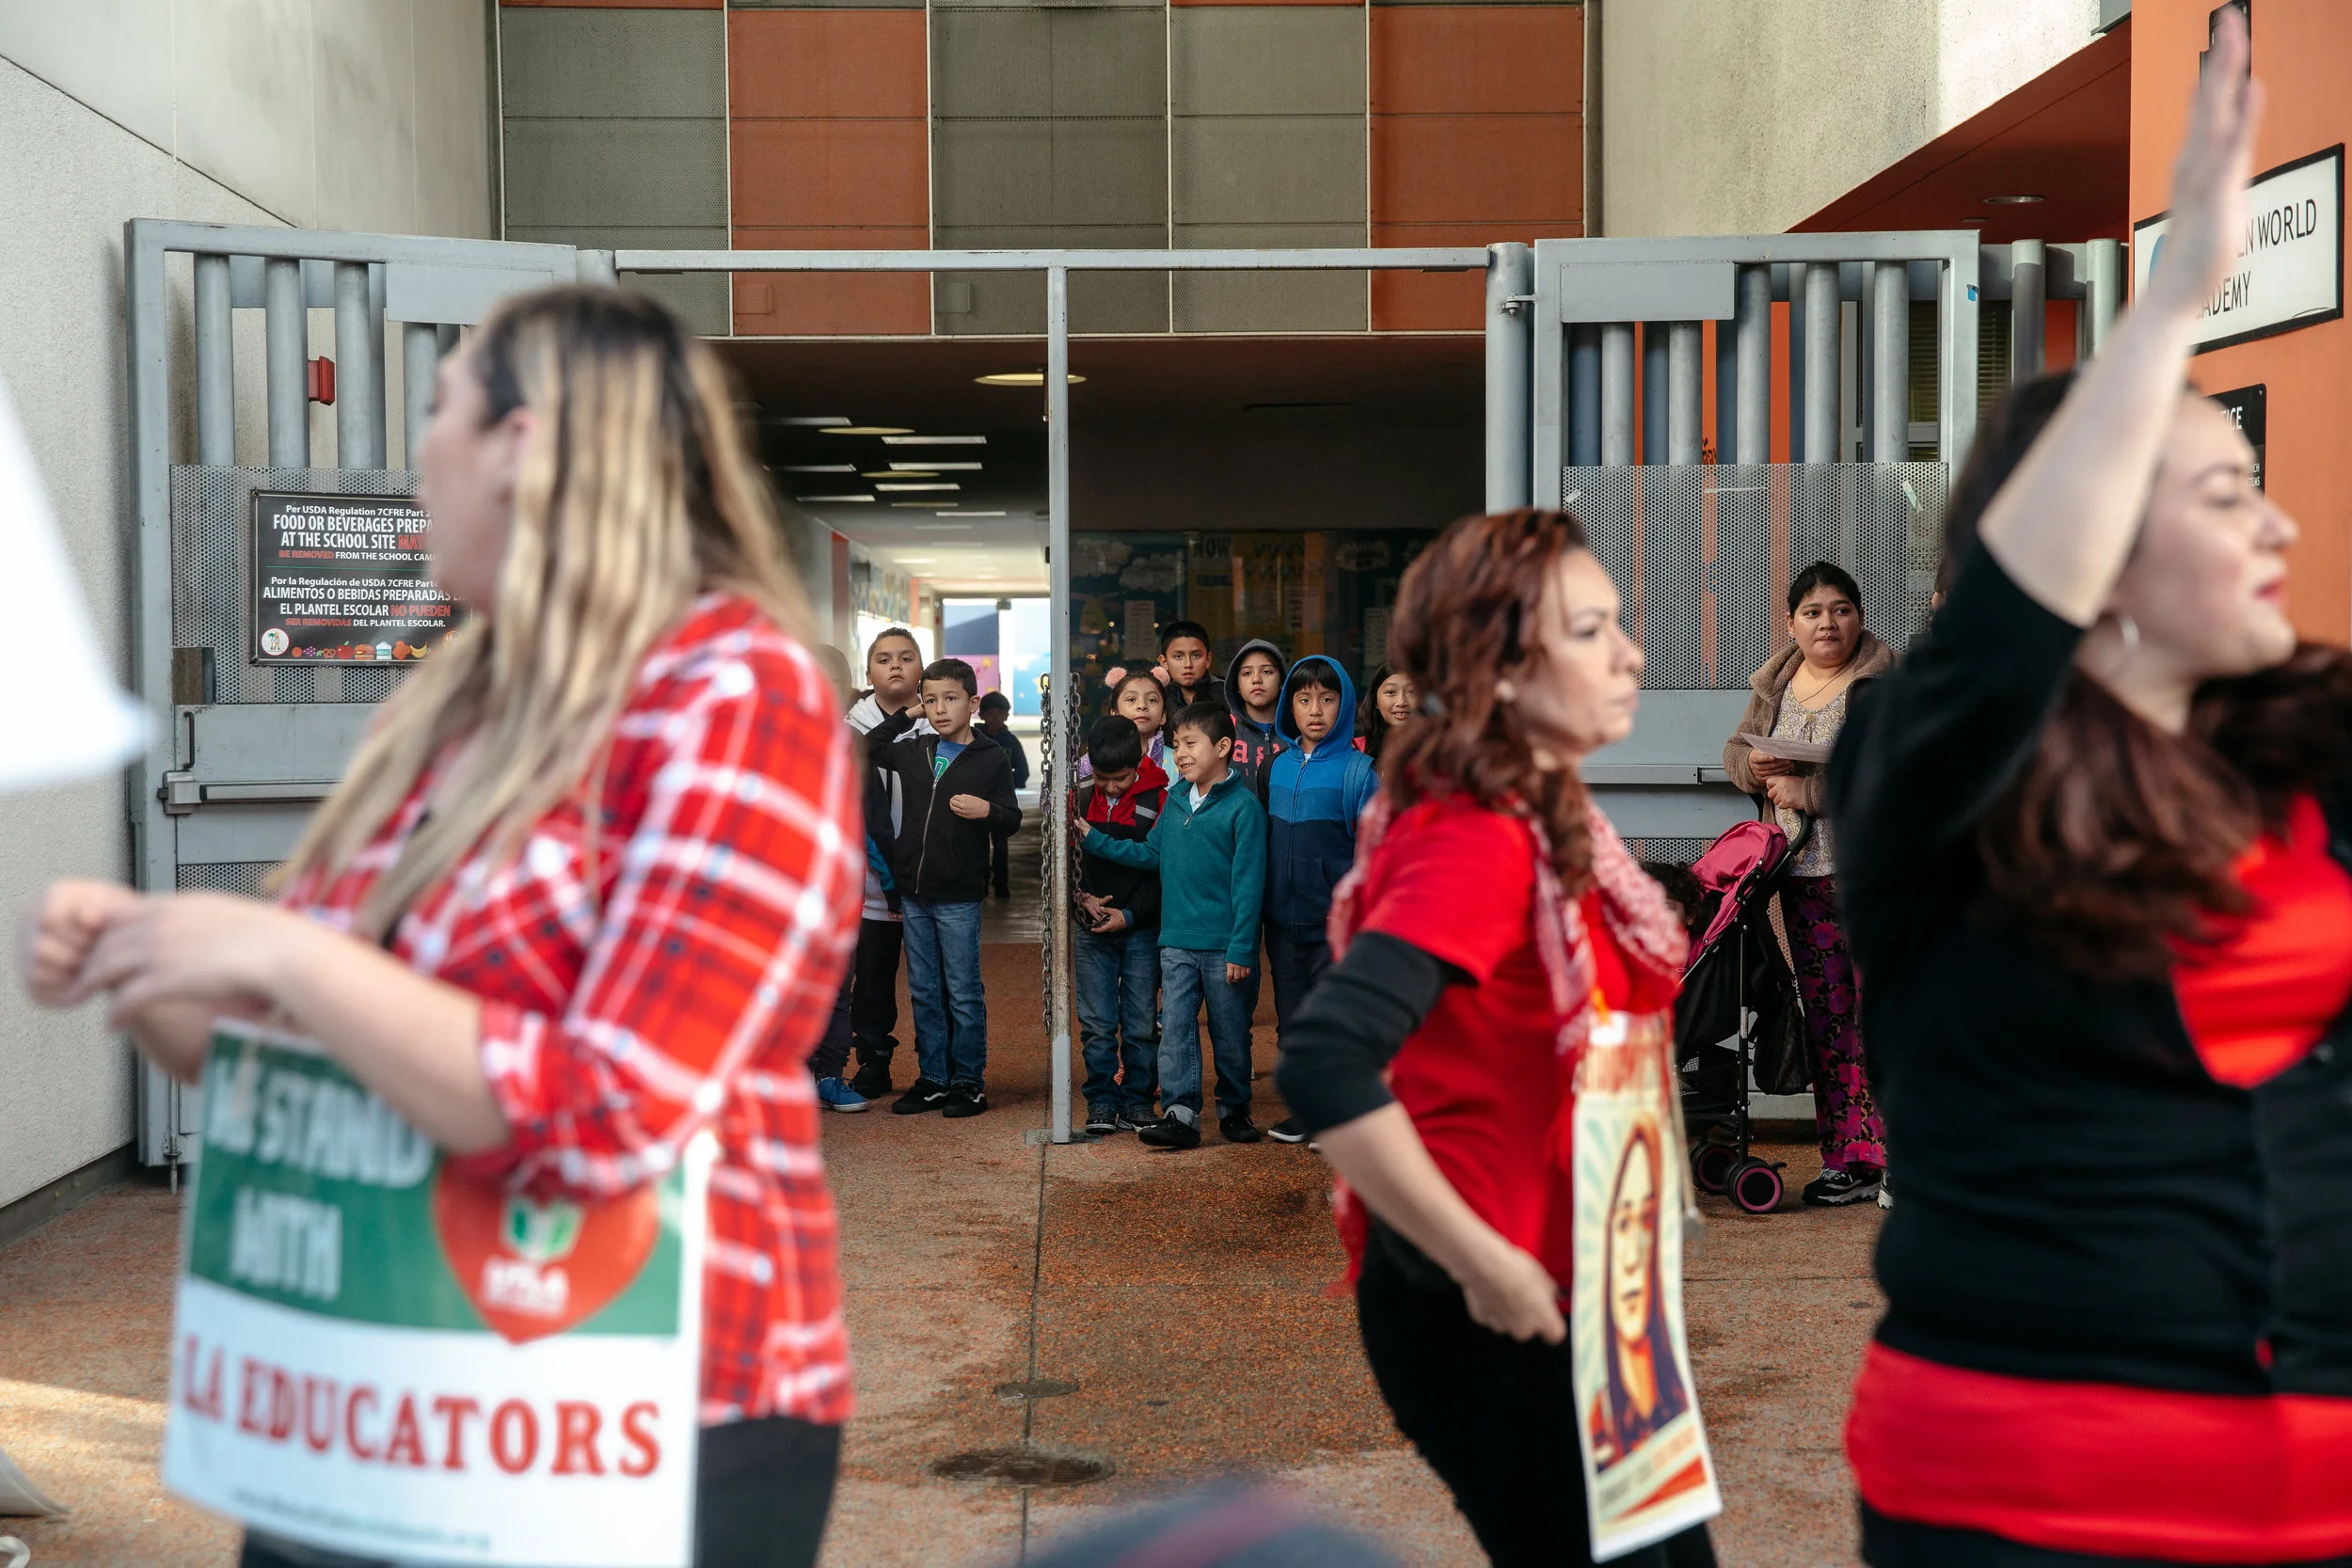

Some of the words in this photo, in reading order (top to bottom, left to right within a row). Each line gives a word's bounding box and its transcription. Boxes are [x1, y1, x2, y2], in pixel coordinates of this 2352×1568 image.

[2258, 198, 2317, 251] WORLD
[2196, 270, 2251, 319] ADEMY
[2220, 406, 2243, 430] TICE
[286, 505, 301, 514] Per
[302, 505, 327, 515] USDA
[329, 506, 376, 517] Regulation
[377, 508, 405, 516] 7CFRE
[405, 509, 424, 517] Part
[273, 514, 306, 531] FOOD
[308, 515, 325, 531] OR
[327, 516, 395, 533] BEVERAGES
[396, 518, 434, 534] PREPA
[280, 531, 296, 546] AT
[297, 532, 321, 547] THE
[323, 532, 369, 549] SCHOOL
[371, 534, 396, 549] SITE
[398, 534, 423, 550] MAY
[278, 549, 291, 559] BE
[292, 550, 334, 560] REMOVED
[335, 551, 360, 561] FROM
[360, 552, 377, 561] THE
[378, 552, 413, 562] SCHOOL
[271, 576, 287, 585] Por
[288, 577, 297, 585] la
[298, 576, 347, 588] Regulación
[349, 578, 360, 587] de
[361, 578, 387, 587] USDA
[388, 579, 414, 588] 7CFRE
[263, 586, 325, 600] ALIMENTOS
[326, 588, 336, 600] O
[338, 588, 381, 601] BEBIDAS
[383, 589, 451, 602] PREPARADAS
[279, 602, 293, 615] EL
[294, 603, 342, 615] PLANTEL
[343, 603, 389, 616] ESCOLAR
[390, 604, 407, 617] NO
[409, 604, 451, 617] PUEDEN
[285, 617, 301, 626] SER
[302, 618, 352, 627] REMOVIDAS
[353, 618, 369, 626] DEL
[370, 619, 406, 627] PLANTEL
[407, 619, 446, 627] ESCOLAR.
[257, 1068, 435, 1189] STAND
[183, 1334, 224, 1422] LA
[237, 1357, 661, 1479] EDUCATORS
